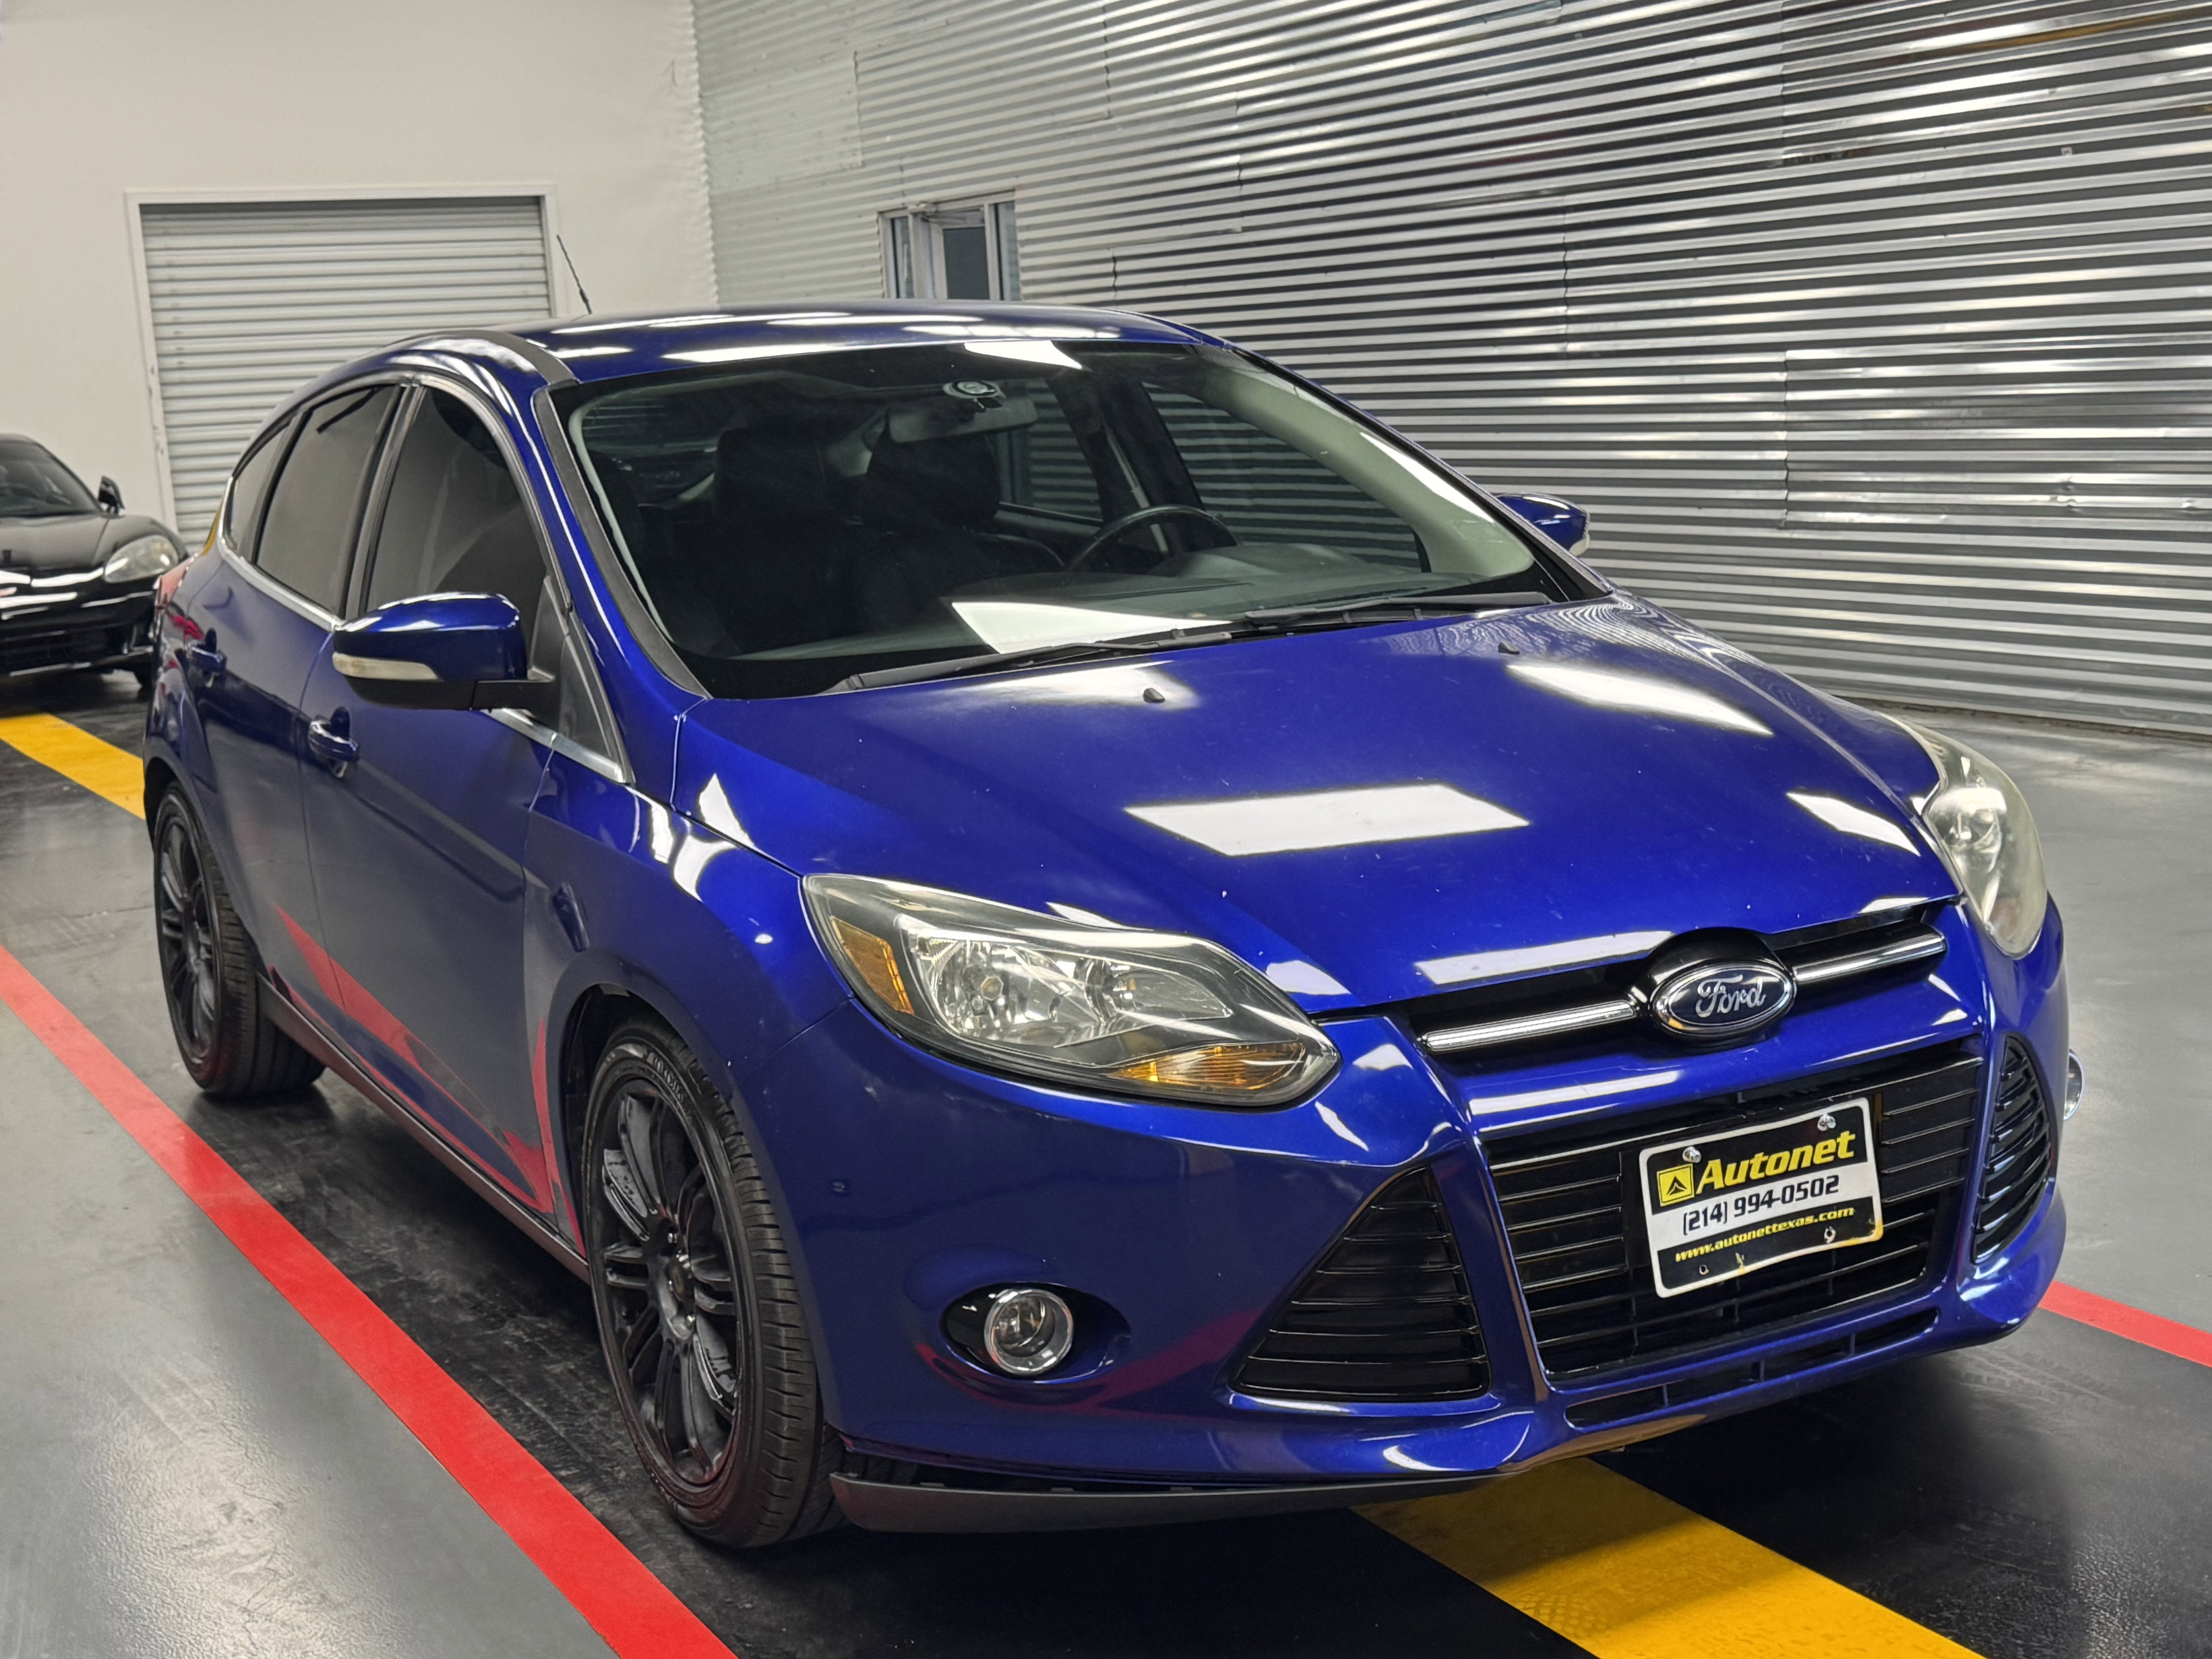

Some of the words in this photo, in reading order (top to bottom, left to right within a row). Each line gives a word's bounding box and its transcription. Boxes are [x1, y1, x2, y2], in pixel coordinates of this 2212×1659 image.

[1695, 974, 1766, 1018] Ford
[1695, 1130, 1856, 1194] Autonet
[1675, 1207, 1855, 1262] www.autonettexas.com
[1683, 1202, 1728, 1236] (214)
[1734, 1175, 1839, 1217] 994-0502
